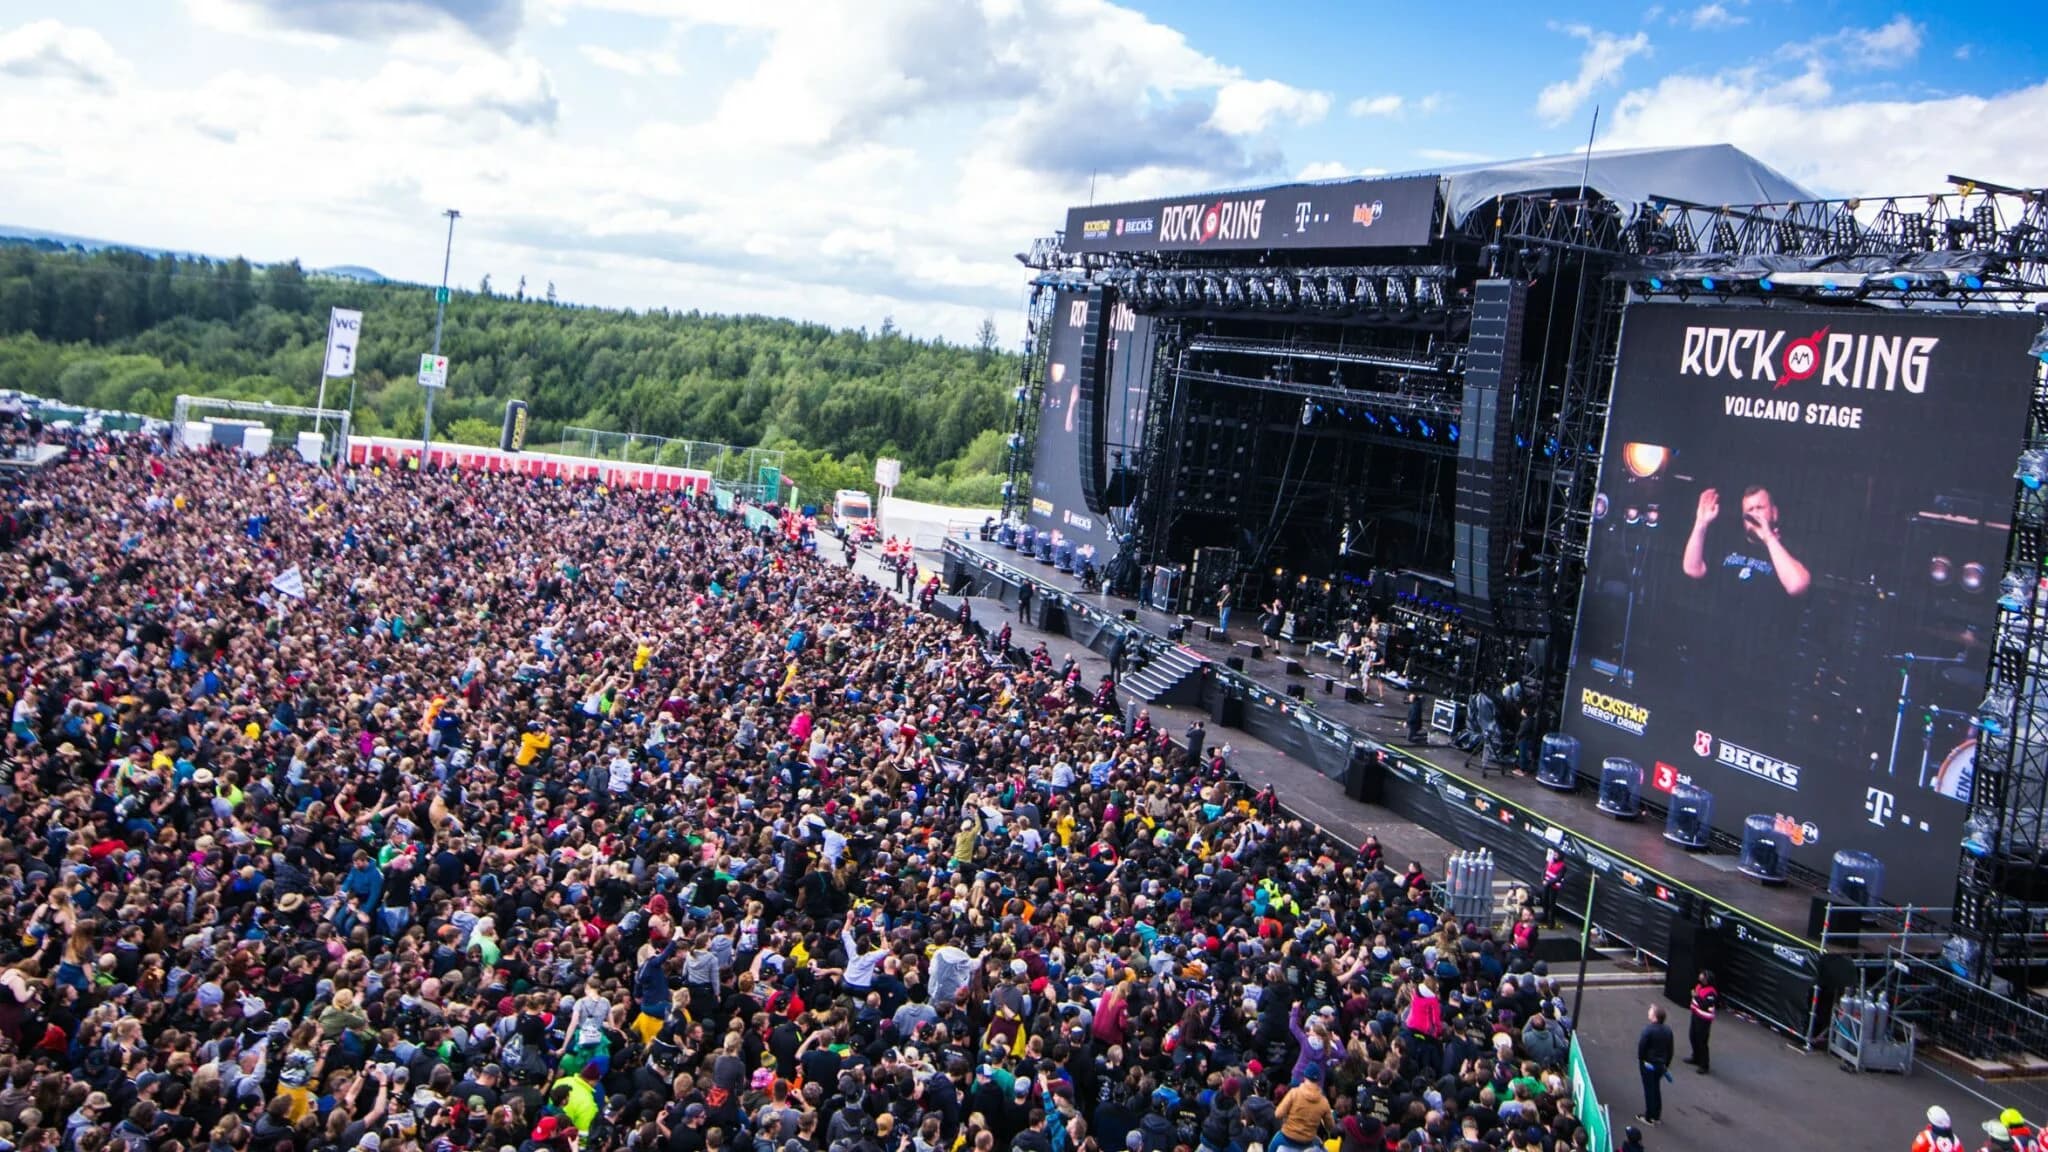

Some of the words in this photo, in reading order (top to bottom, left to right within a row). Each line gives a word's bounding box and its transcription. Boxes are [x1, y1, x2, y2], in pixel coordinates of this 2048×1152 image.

[1160, 203, 1205, 242] ROCK
[1218, 199, 1266, 241] RING
[335, 318, 358, 330] WC
[1680, 327, 1786, 381] ROCK
[1822, 333, 1939, 393] RING
[1725, 395, 1799, 422] VOLCANO
[1805, 403, 1862, 428] STAGE
[1582, 688, 1649, 726] ROCKSTAR
[1582, 704, 1616, 722] ENERGY
[1616, 716, 1645, 733] DRINK
[1718, 741, 1799, 786] BECK'S
